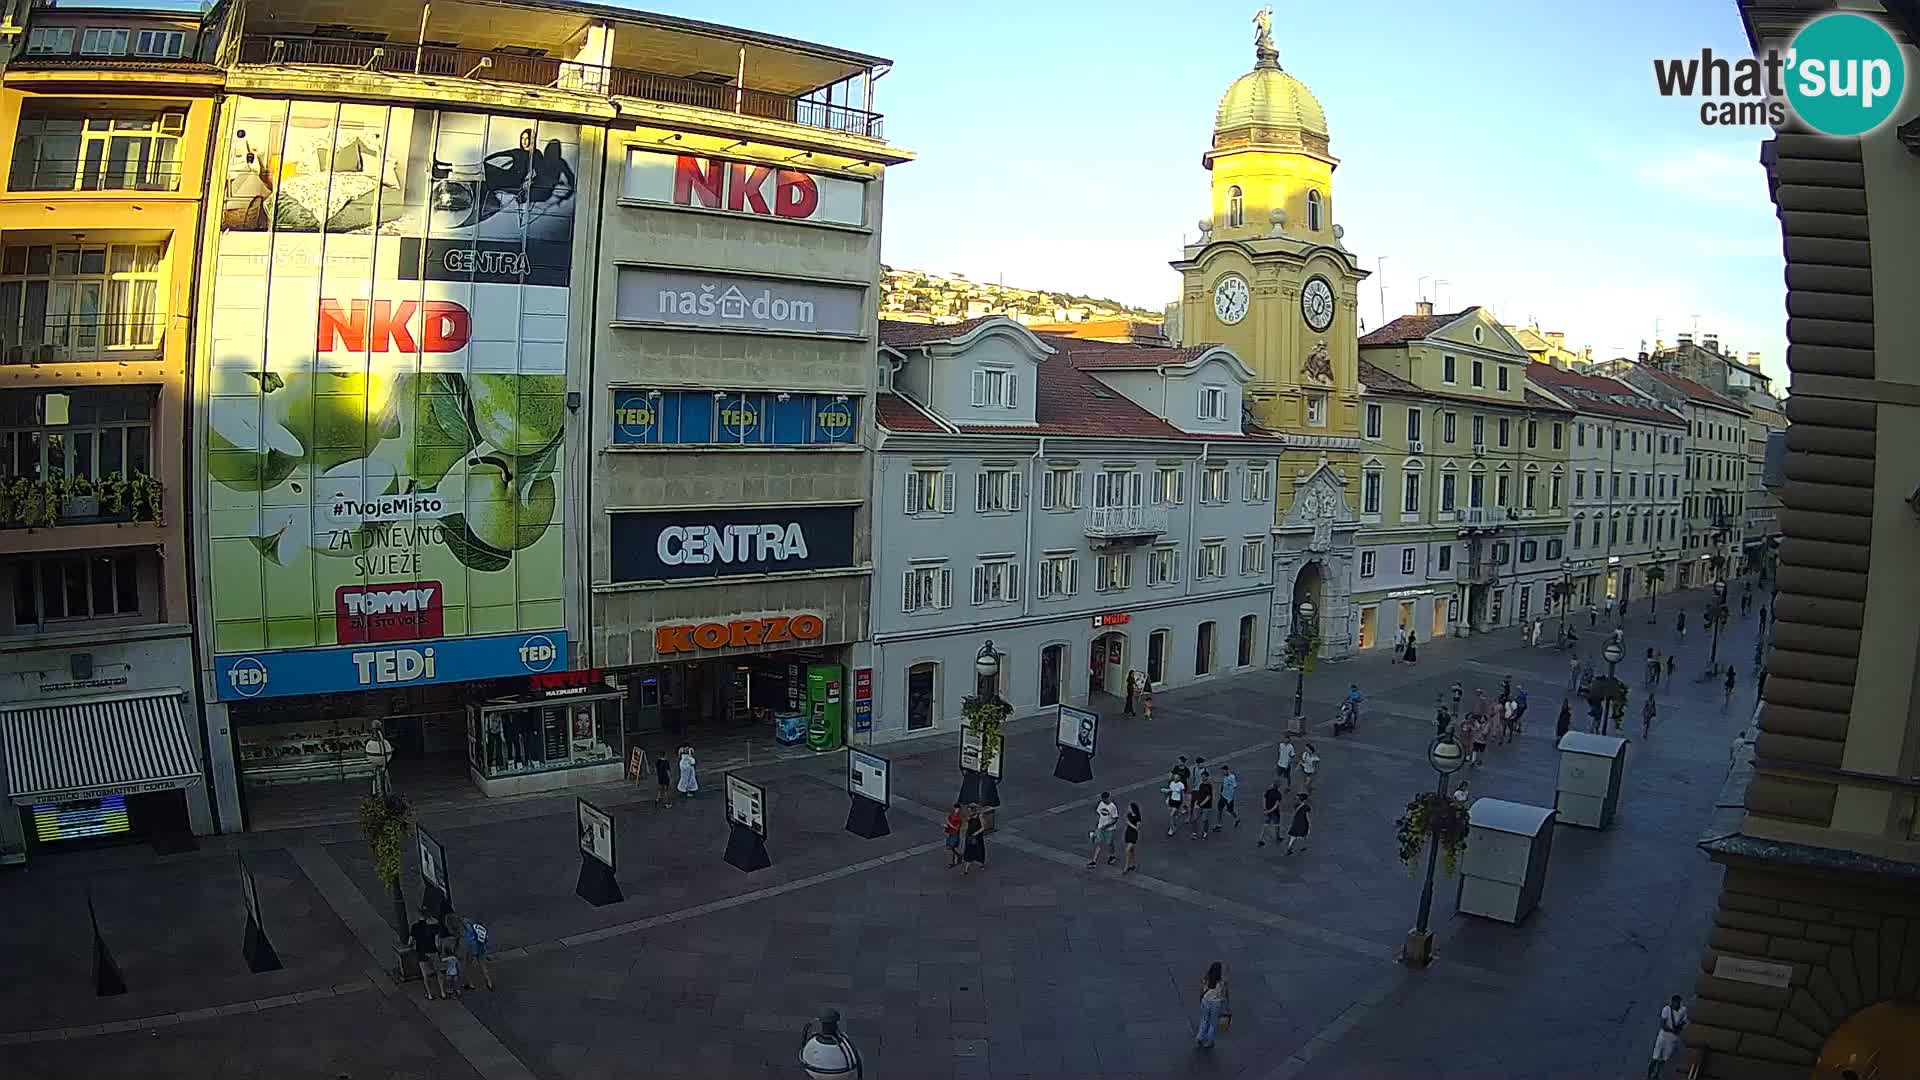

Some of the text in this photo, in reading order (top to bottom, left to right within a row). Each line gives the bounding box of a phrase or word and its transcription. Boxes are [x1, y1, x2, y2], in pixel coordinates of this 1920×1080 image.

[674, 155, 819, 219] NKD
[444, 249, 531, 276] CENTRA
[659, 283, 814, 323] naš dom
[317, 297, 473, 354] NKD
[616, 408, 655, 425] TEDi
[721, 409, 758, 426] TEDi
[818, 411, 851, 427] TEDi
[333, 497, 442, 518] #TvojeMisto
[328, 525, 446, 550] ZA DNEVNO
[657, 522, 809, 565] CENTRA
[354, 548, 422, 577] SVJEŽE
[343, 587, 435, 616] TOMMY
[656, 614, 824, 655] KORZO
[353, 647, 436, 684] TEDi
[519, 645, 557, 664] TEDi
[228, 667, 268, 688] TEDi
